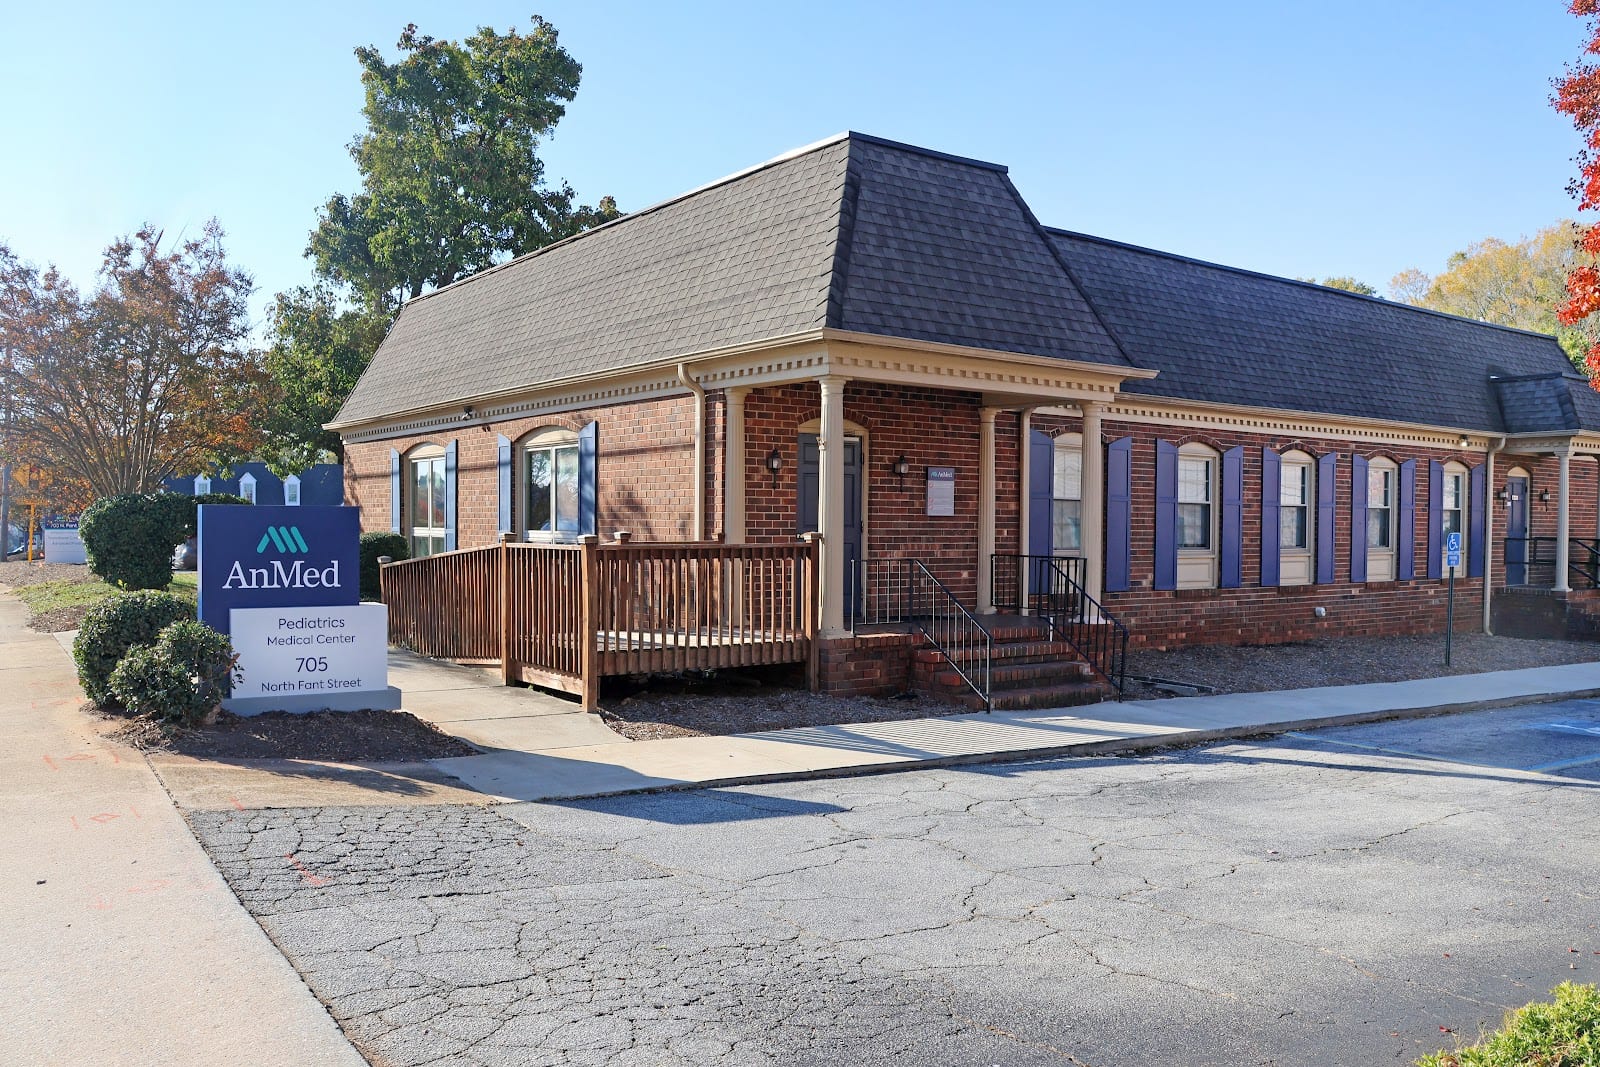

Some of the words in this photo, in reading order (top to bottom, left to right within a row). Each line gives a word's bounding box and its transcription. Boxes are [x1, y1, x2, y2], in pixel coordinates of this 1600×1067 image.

[222, 560, 341, 589] AnMed
[278, 617, 345, 630] Pediatrics
[267, 634, 314, 646] Medical
[317, 634, 356, 645] Center
[296, 656, 328, 673] 705
[262, 681, 295, 692] North
[299, 680, 324, 690] Fant
[327, 677, 362, 689] Street
